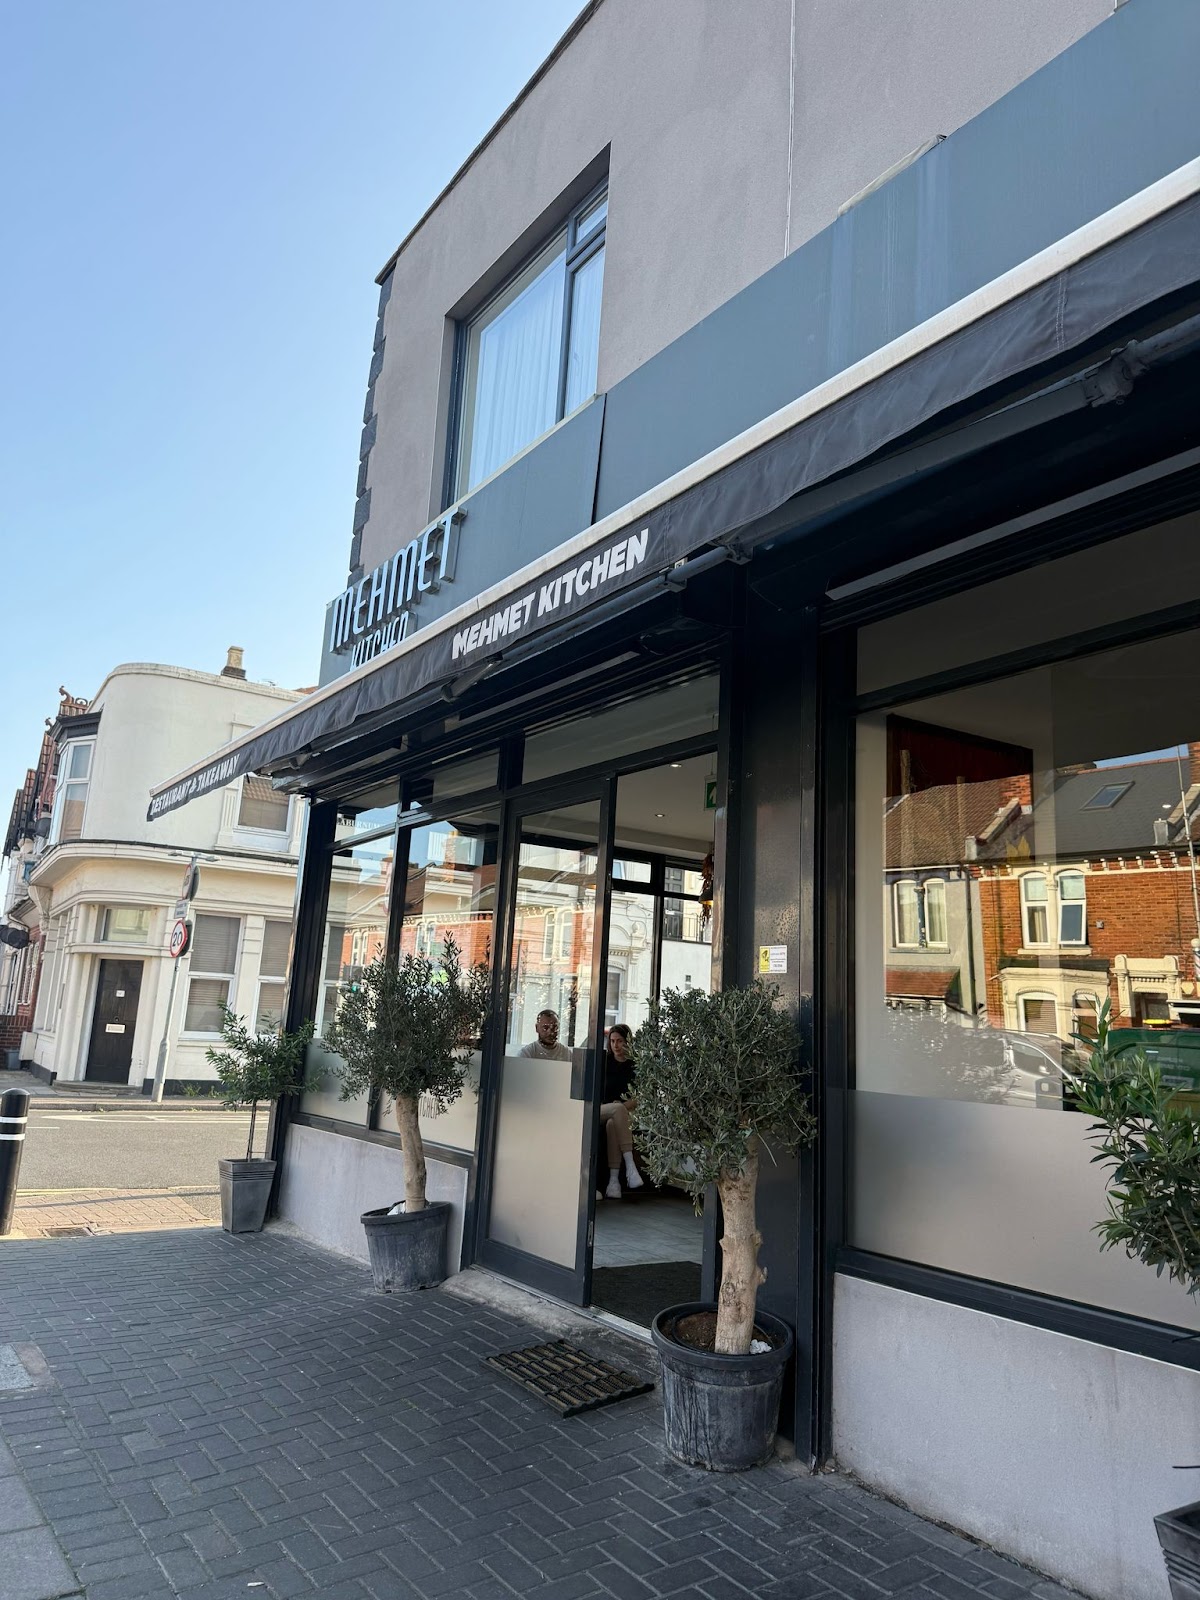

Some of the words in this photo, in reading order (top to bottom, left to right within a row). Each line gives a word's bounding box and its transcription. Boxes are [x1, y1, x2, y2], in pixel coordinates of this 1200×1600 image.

[330, 507, 462, 653] MEHMET
[452, 592, 536, 659] MEHMET
[537, 528, 649, 617] KITCHEN
[150, 780, 192, 815] RESTAURANT
[189, 777, 198, 794] &
[197, 754, 240, 791] TAKEAWAY
[172, 931, 183, 947] 20
